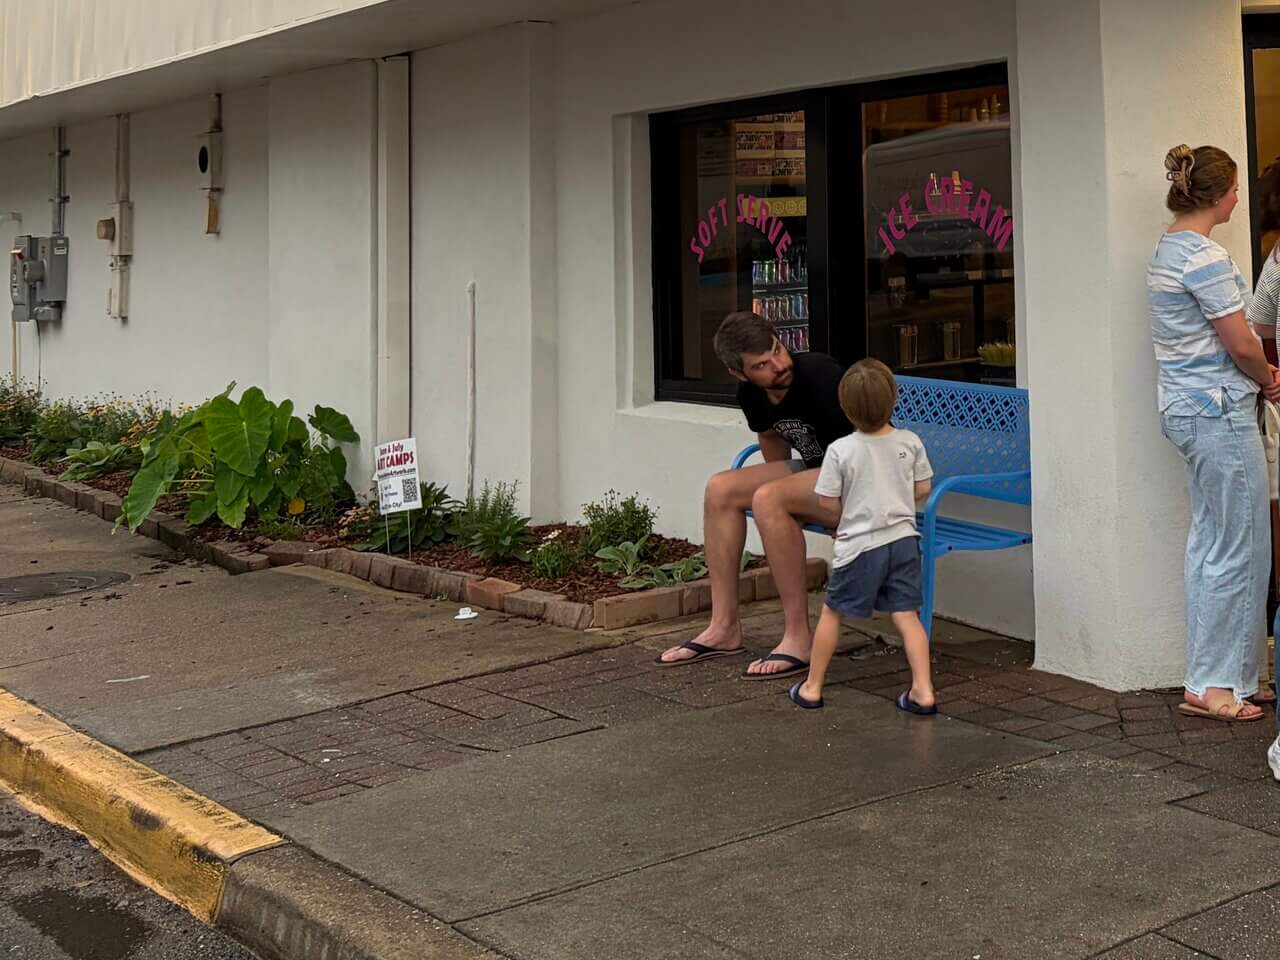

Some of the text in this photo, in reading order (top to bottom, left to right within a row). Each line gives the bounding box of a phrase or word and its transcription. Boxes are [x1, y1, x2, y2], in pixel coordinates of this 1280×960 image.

[690, 192, 793, 265] SOFT SERVE
[878, 175, 1014, 256] ICE CREAM
[386, 451, 414, 467] CAMPS
